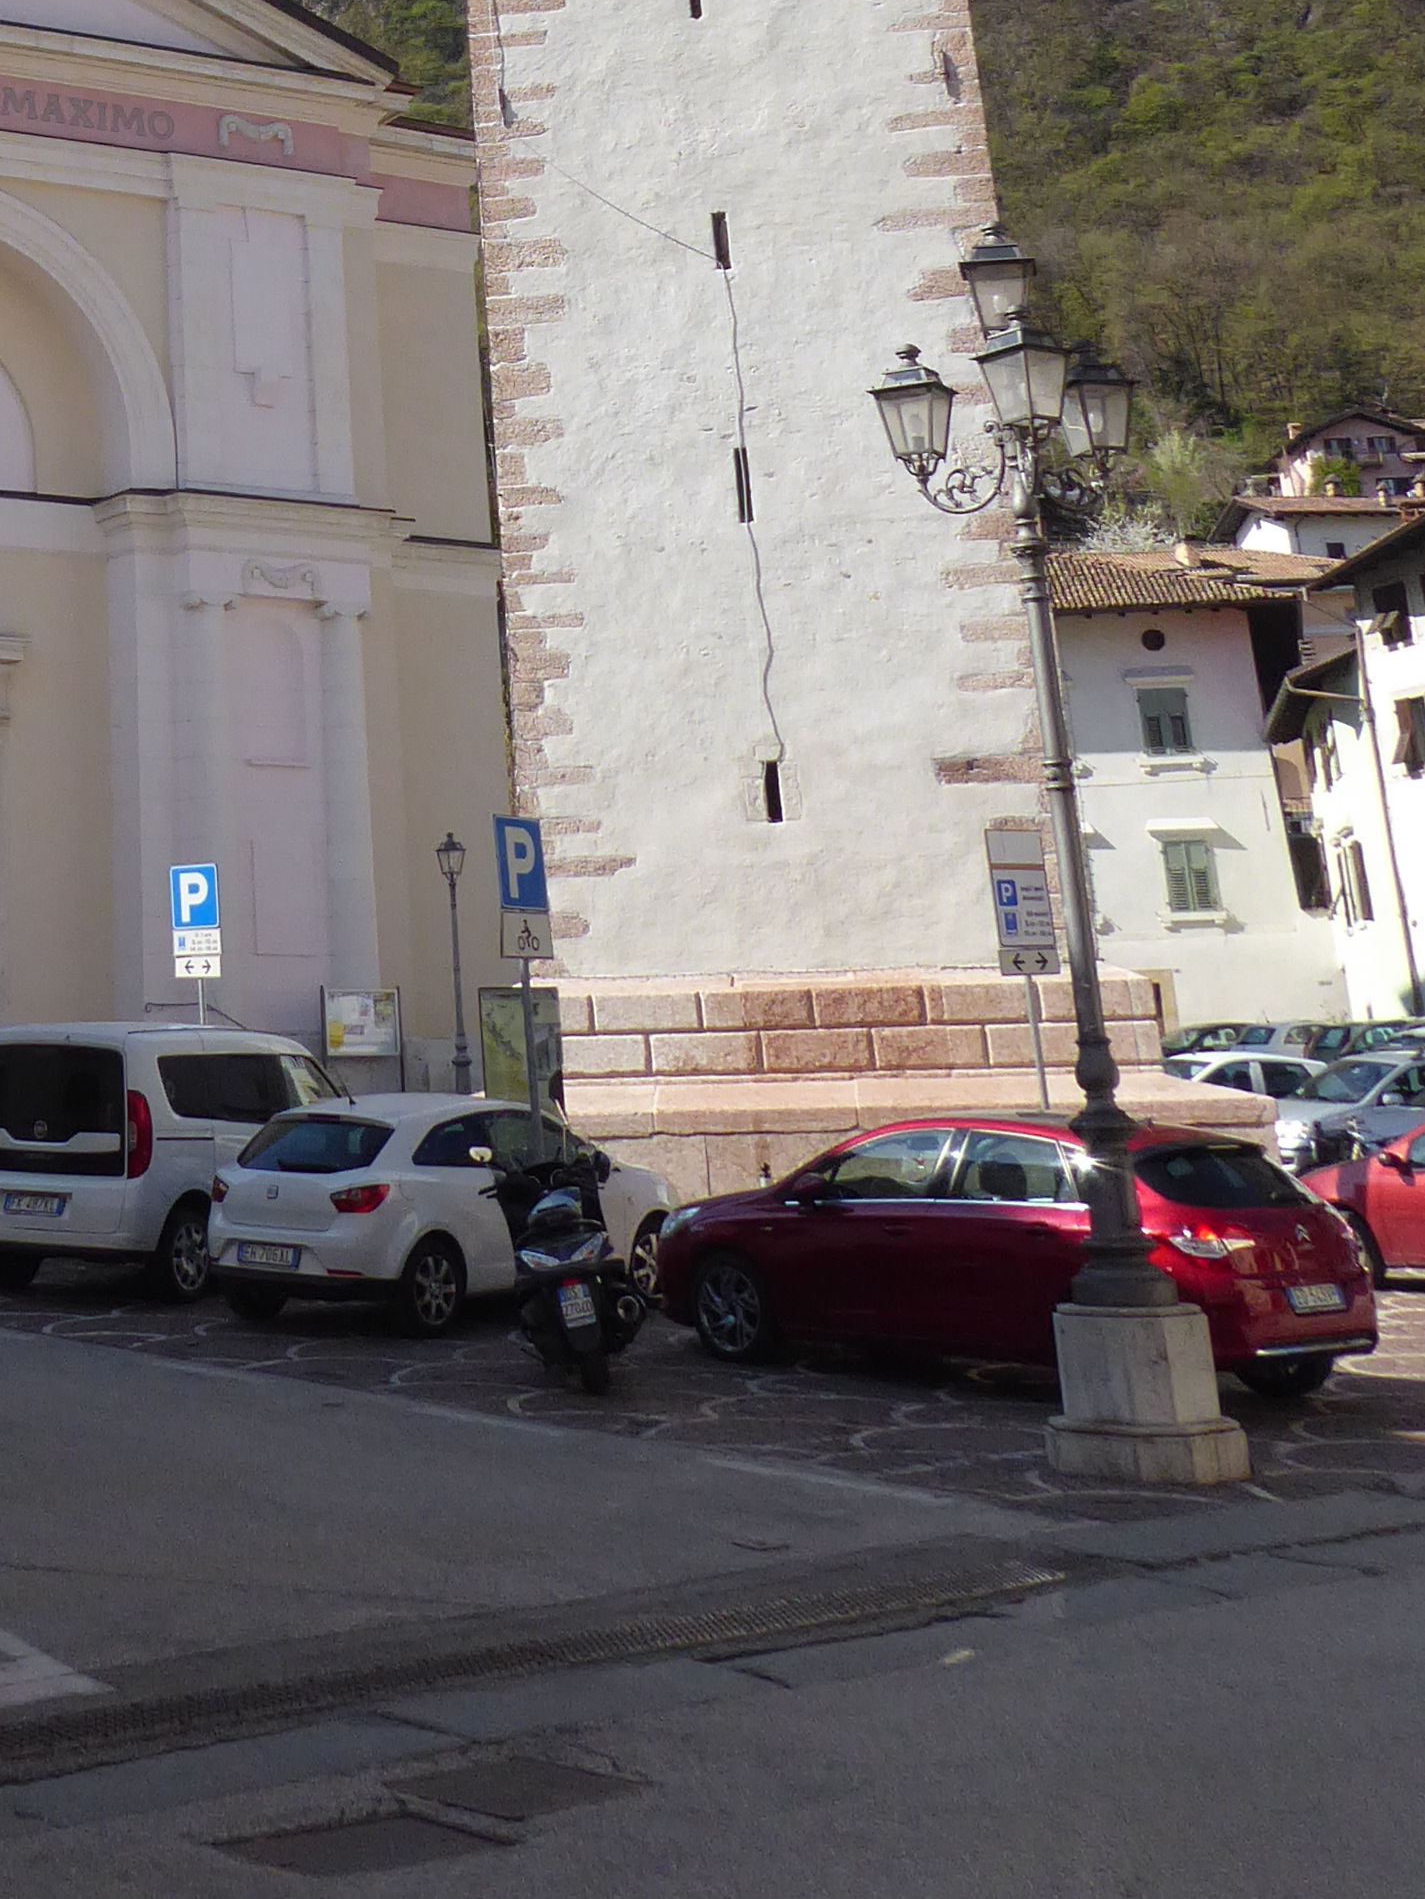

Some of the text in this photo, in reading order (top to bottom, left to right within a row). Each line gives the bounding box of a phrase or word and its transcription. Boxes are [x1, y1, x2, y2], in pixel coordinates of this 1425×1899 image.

[0, 86, 175, 140] MAXIMO
[504, 825, 536, 899] P
[179, 871, 209, 923] P
[1000, 883, 1013, 903] P
